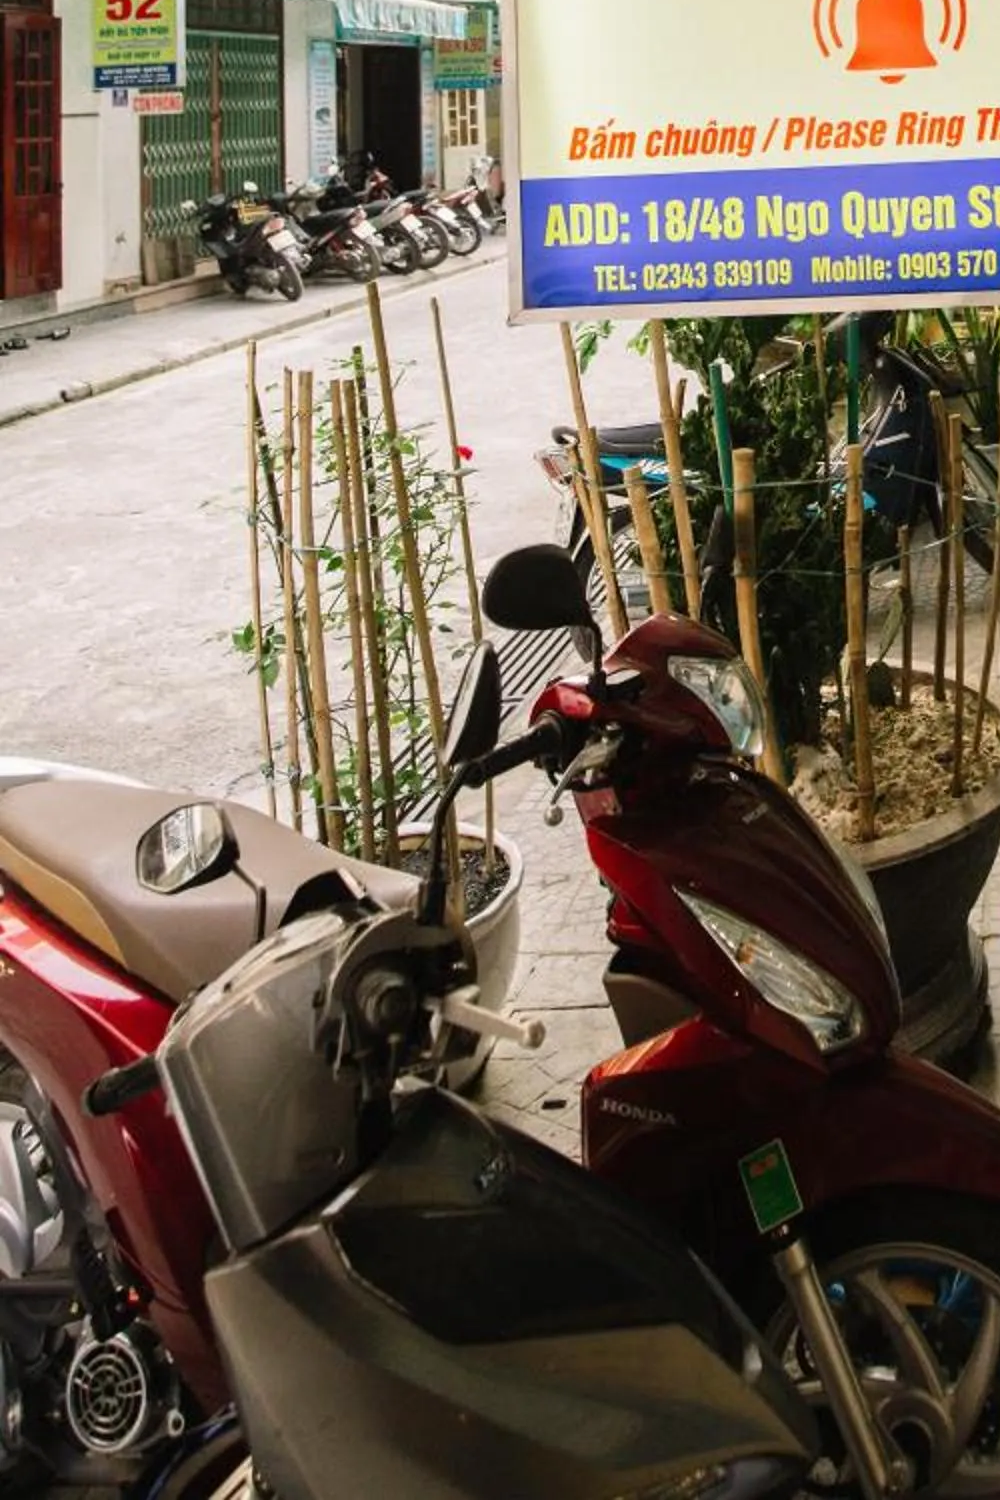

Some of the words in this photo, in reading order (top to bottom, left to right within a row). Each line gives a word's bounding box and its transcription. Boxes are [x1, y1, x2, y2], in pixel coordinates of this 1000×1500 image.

[568, 118, 638, 161] Bấm
[644, 119, 757, 158] chuông
[783, 115, 888, 152] Please
[895, 110, 965, 148] Ring
[544, 202, 631, 247] ADD:
[642, 195, 746, 243] 18/48
[755, 194, 830, 243] Ngo
[841, 190, 957, 239] Quyen
[593, 264, 637, 293] TEL:
[642, 261, 708, 292] 02343
[714, 258, 793, 289] 839109
[810, 254, 893, 285] Mobile:
[898, 251, 952, 281] 0903
[956, 248, 998, 278] 570
[599, 1097, 678, 1127] HONDA
